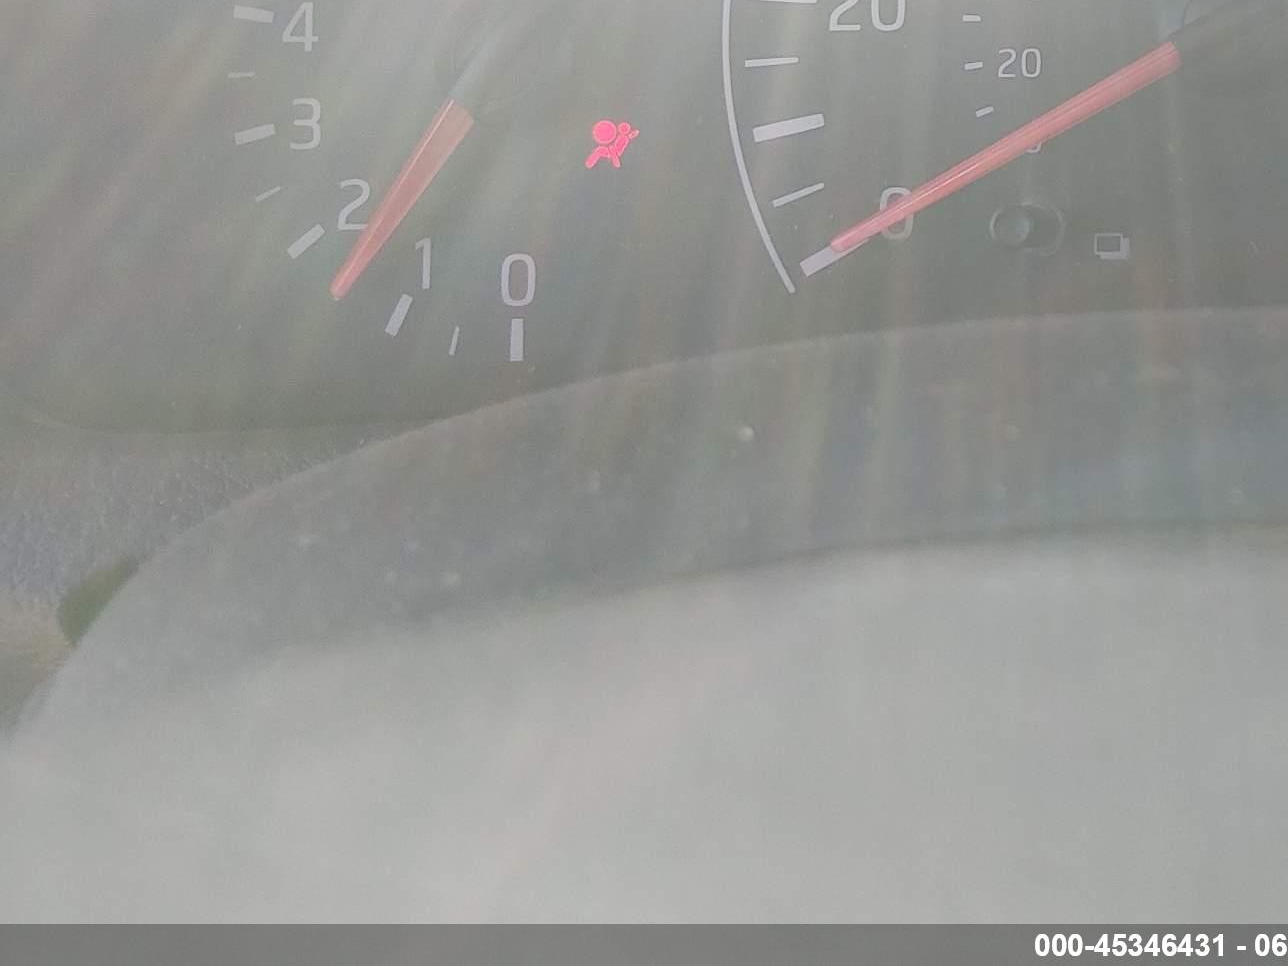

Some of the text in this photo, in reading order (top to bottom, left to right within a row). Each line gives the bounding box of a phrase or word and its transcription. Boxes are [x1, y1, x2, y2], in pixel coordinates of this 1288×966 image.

[283, 2, 319, 52] 4
[996, 49, 1043, 78] 20
[289, 98, 321, 150] 3
[337, 179, 370, 231] 2
[878, 187, 916, 240] 0
[415, 238, 431, 289] 1
[501, 254, 535, 306] 0
